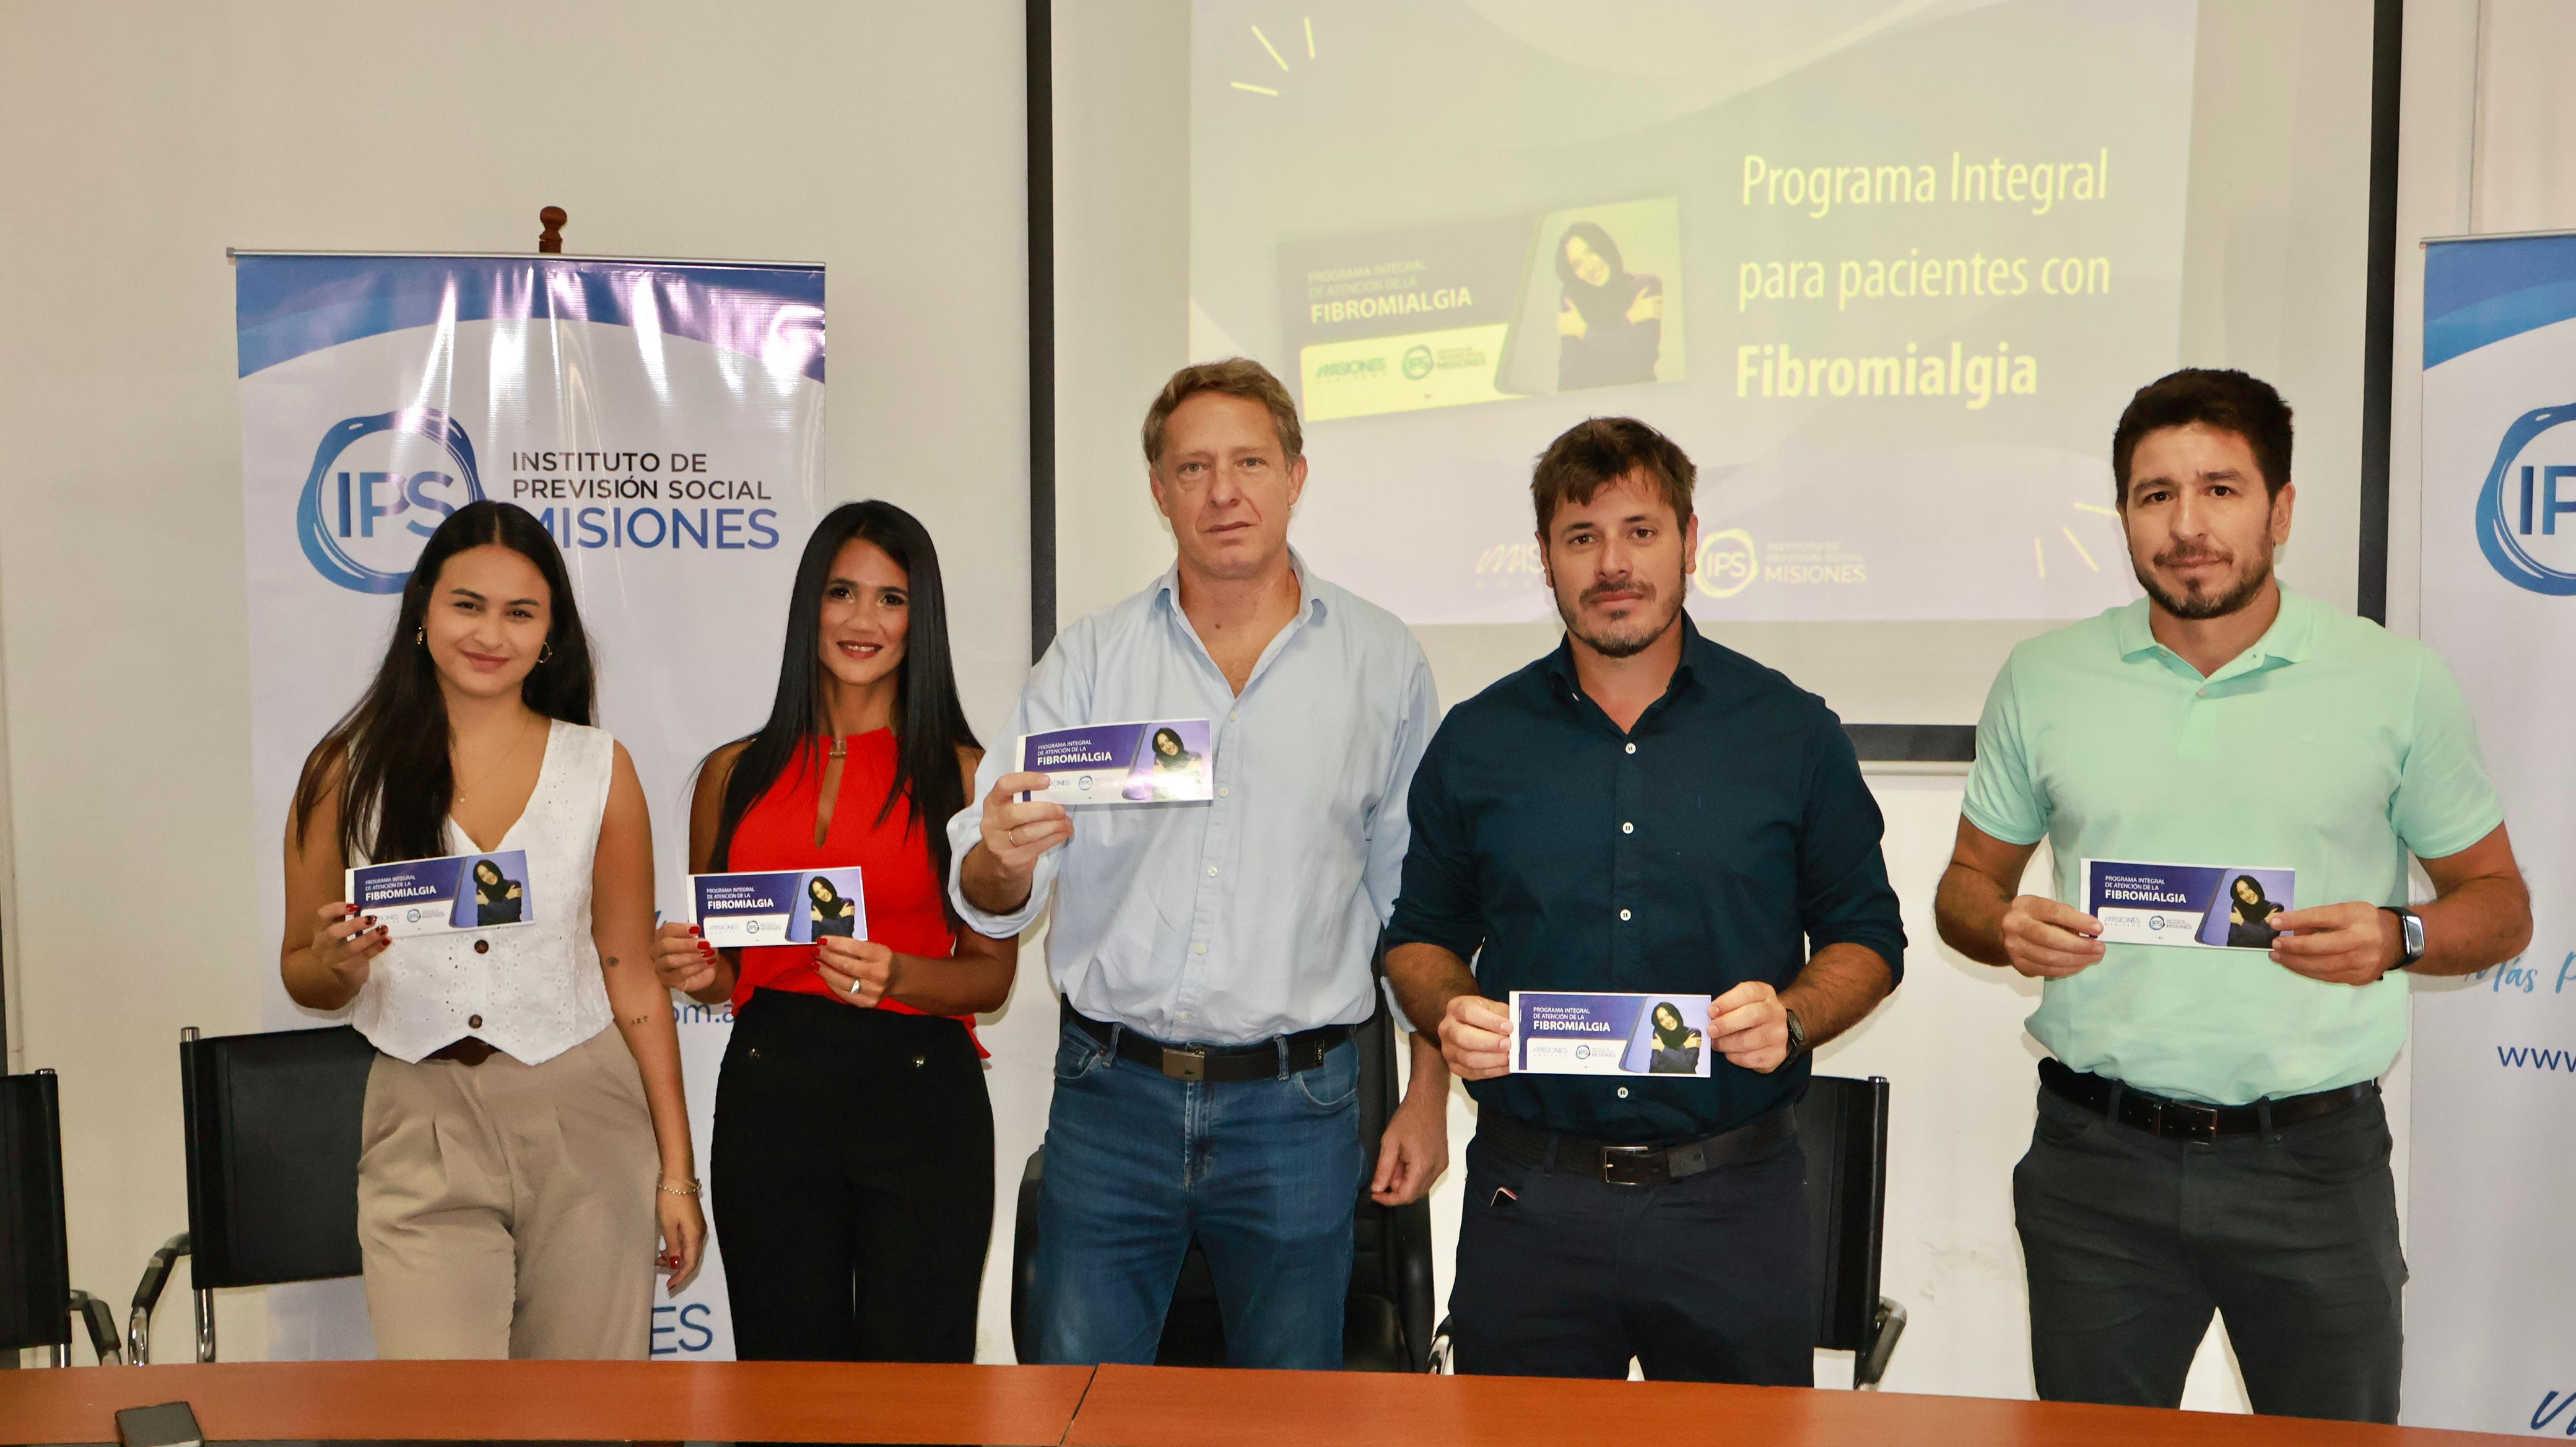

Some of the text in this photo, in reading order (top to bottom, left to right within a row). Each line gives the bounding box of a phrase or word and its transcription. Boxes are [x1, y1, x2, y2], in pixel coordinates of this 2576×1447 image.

[1743, 147, 2108, 218] Programa Integral
[1739, 248, 2110, 312] para pacientes con
[1310, 286, 1474, 325] FIBROMIALGIA
[1736, 341, 2038, 410] Fibromialgia
[512, 452, 707, 473] INSTITUTO DE
[513, 475, 772, 501] PREVISIÓN SOCIAL
[337, 470, 458, 538] IPS
[1705, 551, 1747, 579] IPS
[1765, 563, 1868, 584] MISIONES
[1037, 742, 1066, 750] PROGRAMA
[1037, 751, 1113, 766] FIBROMIALGIA
[2105, 875, 2138, 883] PROGRAMA
[365, 885, 437, 901] FIBROMIALGIA
[2105, 889, 2187, 904] FIBROMIALGIA
[707, 898, 774, 910] FIBROMIALGIA
[1533, 1020, 1611, 1033] FIBROMIALGIA
